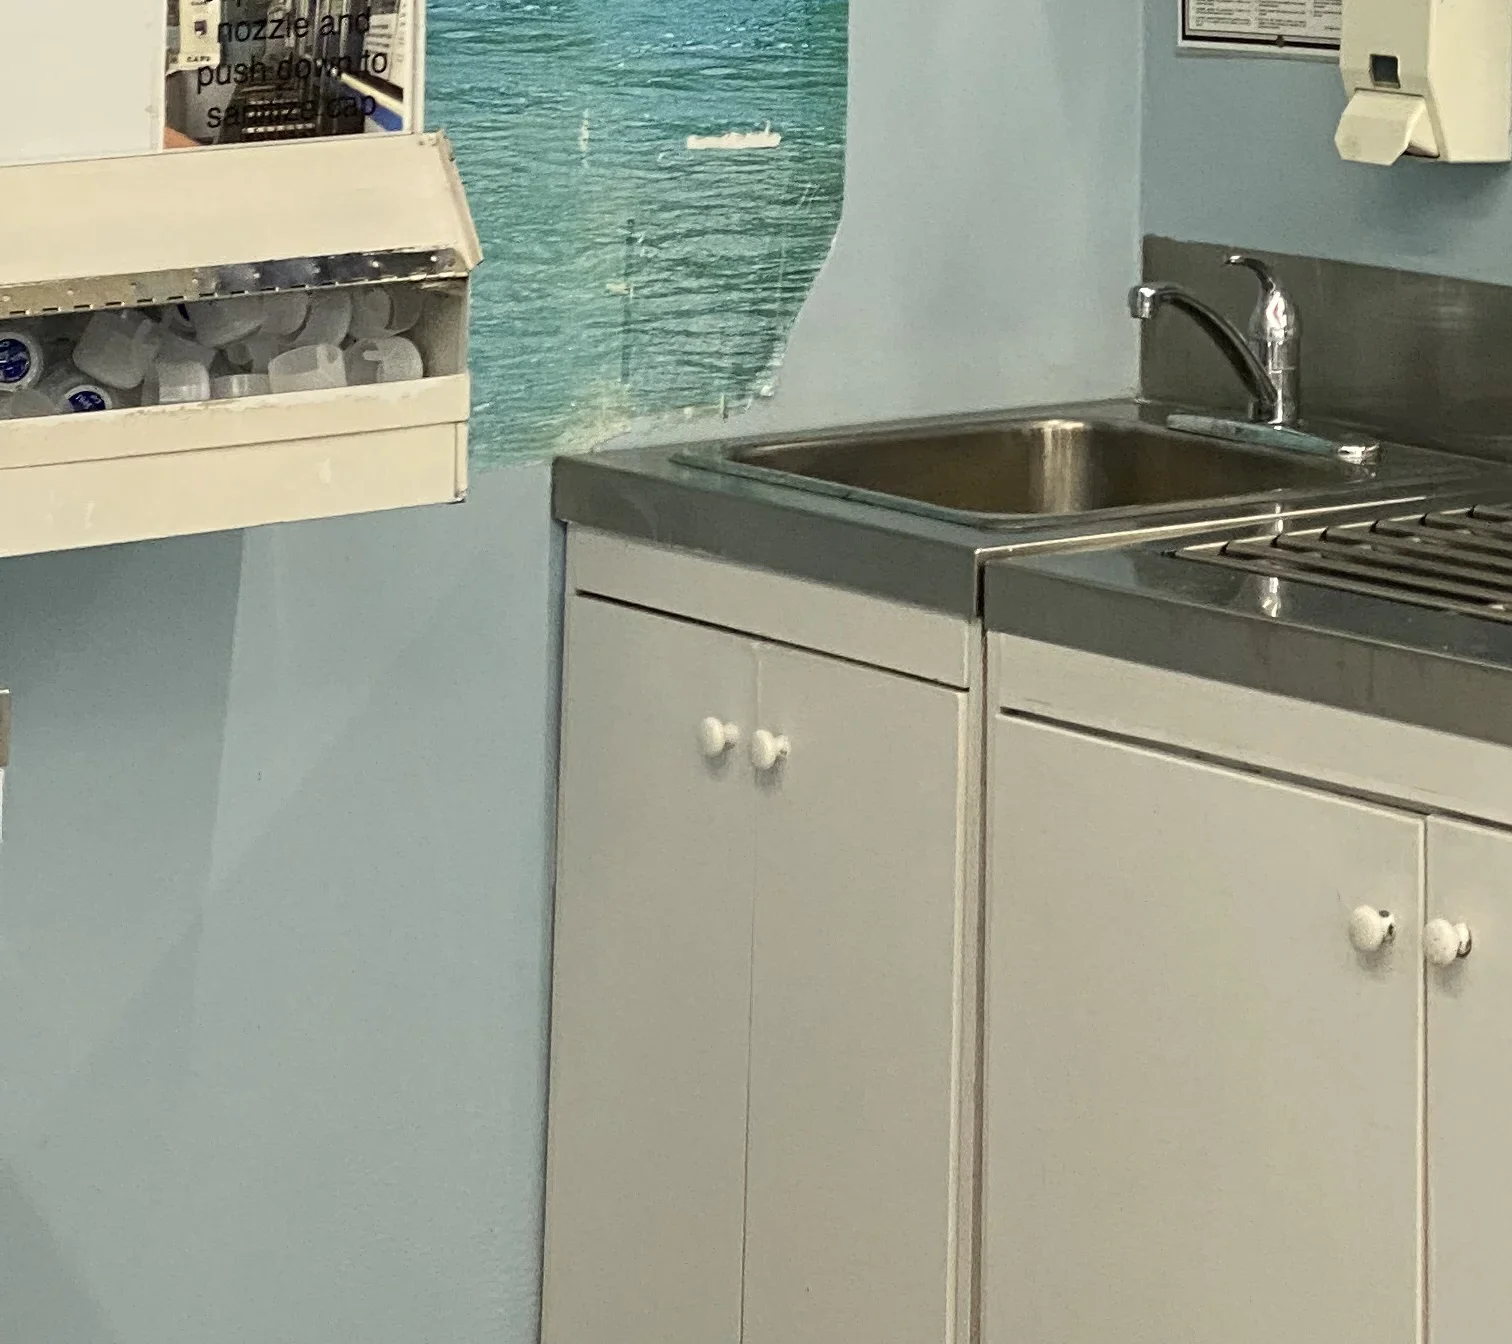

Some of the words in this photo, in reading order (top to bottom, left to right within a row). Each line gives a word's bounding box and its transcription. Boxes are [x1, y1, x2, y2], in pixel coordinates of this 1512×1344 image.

[217, 14, 310, 43] nozzle
[320, 9, 369, 36] and
[197, 55, 266, 94] push
[278, 51, 351, 80] down
[360, 49, 388, 74] to
